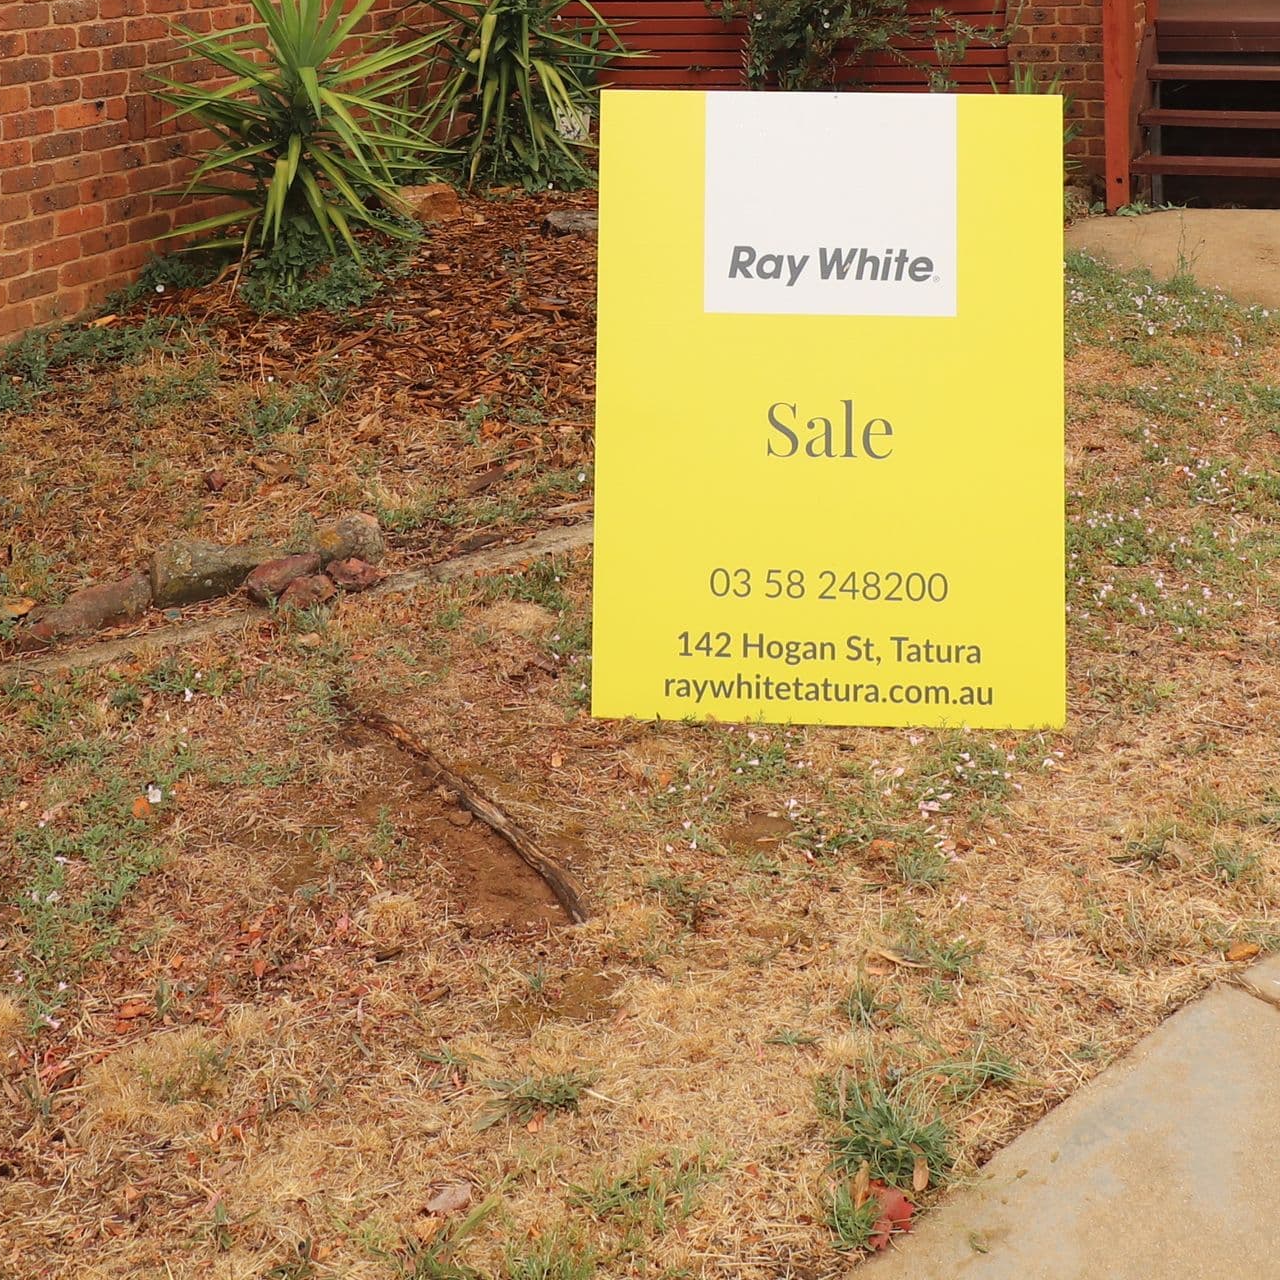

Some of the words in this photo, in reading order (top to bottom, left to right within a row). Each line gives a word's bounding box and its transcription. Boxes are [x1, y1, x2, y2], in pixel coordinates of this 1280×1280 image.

[728, 245, 809, 287] Ray
[819, 247, 934, 282] White
[766, 399, 894, 459] Sale
[709, 567, 752, 598] 03
[765, 569, 806, 600] 58
[817, 570, 949, 603] 248200
[677, 630, 732, 658] 142
[742, 632, 837, 666] Hogan
[845, 635, 883, 666] St,
[890, 636, 982, 664] Tatura
[664, 673, 994, 706] raywhitetatura.com.au
